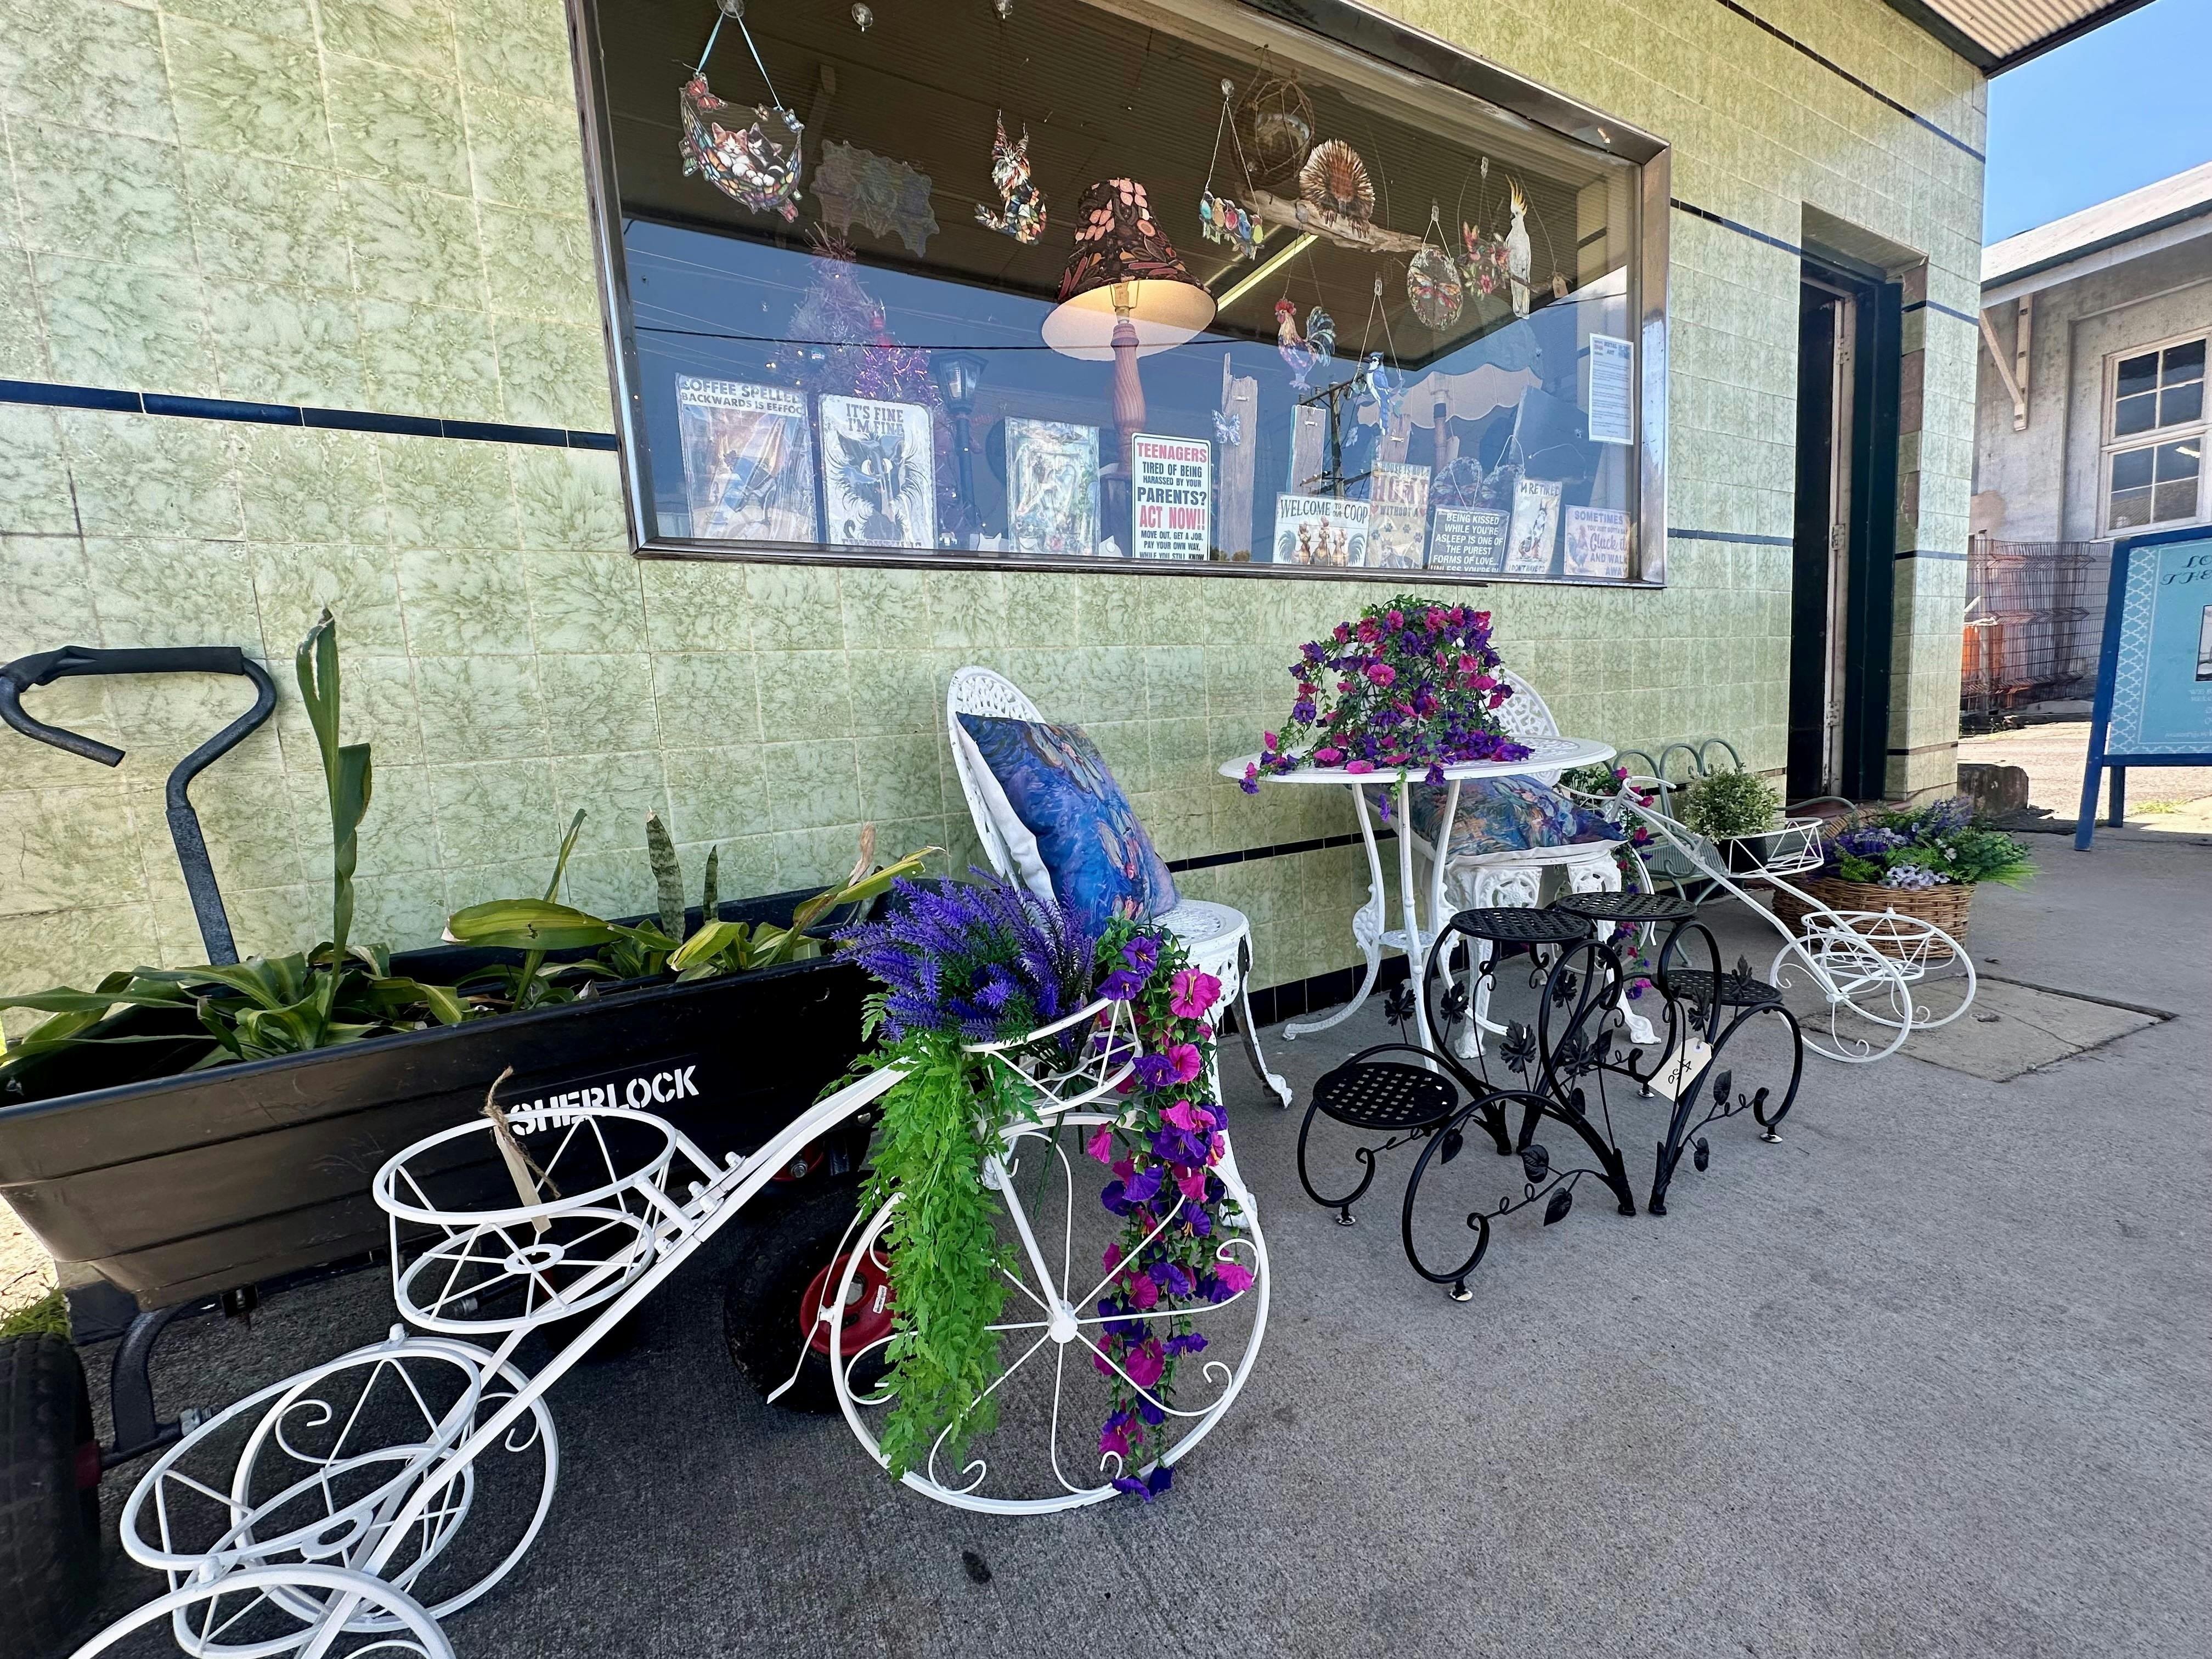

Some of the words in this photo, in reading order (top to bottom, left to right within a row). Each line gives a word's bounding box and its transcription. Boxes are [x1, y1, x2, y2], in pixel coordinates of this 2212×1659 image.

[681, 392, 752, 408] BACKWARDS
[755, 401, 764, 410] IS
[767, 403, 803, 415] EEFFOC
[846, 403, 870, 419] IT'S
[874, 407, 904, 422] FINE
[848, 418, 870, 433] I'M
[873, 420, 904, 437] FINE
[1137, 443, 1207, 463] TEENAGERS
[1143, 461, 1164, 475] TIRED
[1168, 464, 1177, 476] OF
[1181, 465, 1202, 478] BEING
[1143, 475, 1173, 486] HARASSED
[1176, 478, 1183, 486] BY
[1186, 479, 1201, 487] YOUR
[1137, 487, 1207, 505] PARENTS?
[1529, 482, 1559, 496] RETIRED
[1281, 500, 1331, 518] WELCOME
[1345, 504, 1368, 524] COOP
[1380, 506, 1412, 517] WITHOUT
[1139, 505, 1163, 528] ACT
[1169, 507, 1205, 531] NOW!!
[1446, 514, 1471, 522] BEING
[1472, 516, 1499, 525] KISSED
[1575, 510, 1623, 524] SOMETIMES
[1141, 530, 1157, 539] MOVE
[1160, 531, 1171, 540] OUT,
[1444, 524, 1470, 533] WHILE
[1472, 526, 1499, 535] YOU'RE
[1173, 542, 1186, 550] OWN
[1435, 534, 1466, 544] ASLEEP
[1468, 536, 1476, 544] IS
[1477, 537, 1492, 545] ONE
[1494, 538, 1503, 546] OF
[1590, 533, 1618, 552] Cluck
[1446, 545, 1461, 554] THE
[1463, 546, 1492, 555] PUREST
[1433, 555, 1462, 564] FORMS
[1464, 556, 1474, 565] OF
[1590, 553, 1606, 562] AND
[510, 1065, 699, 1136] SHERLOCK
